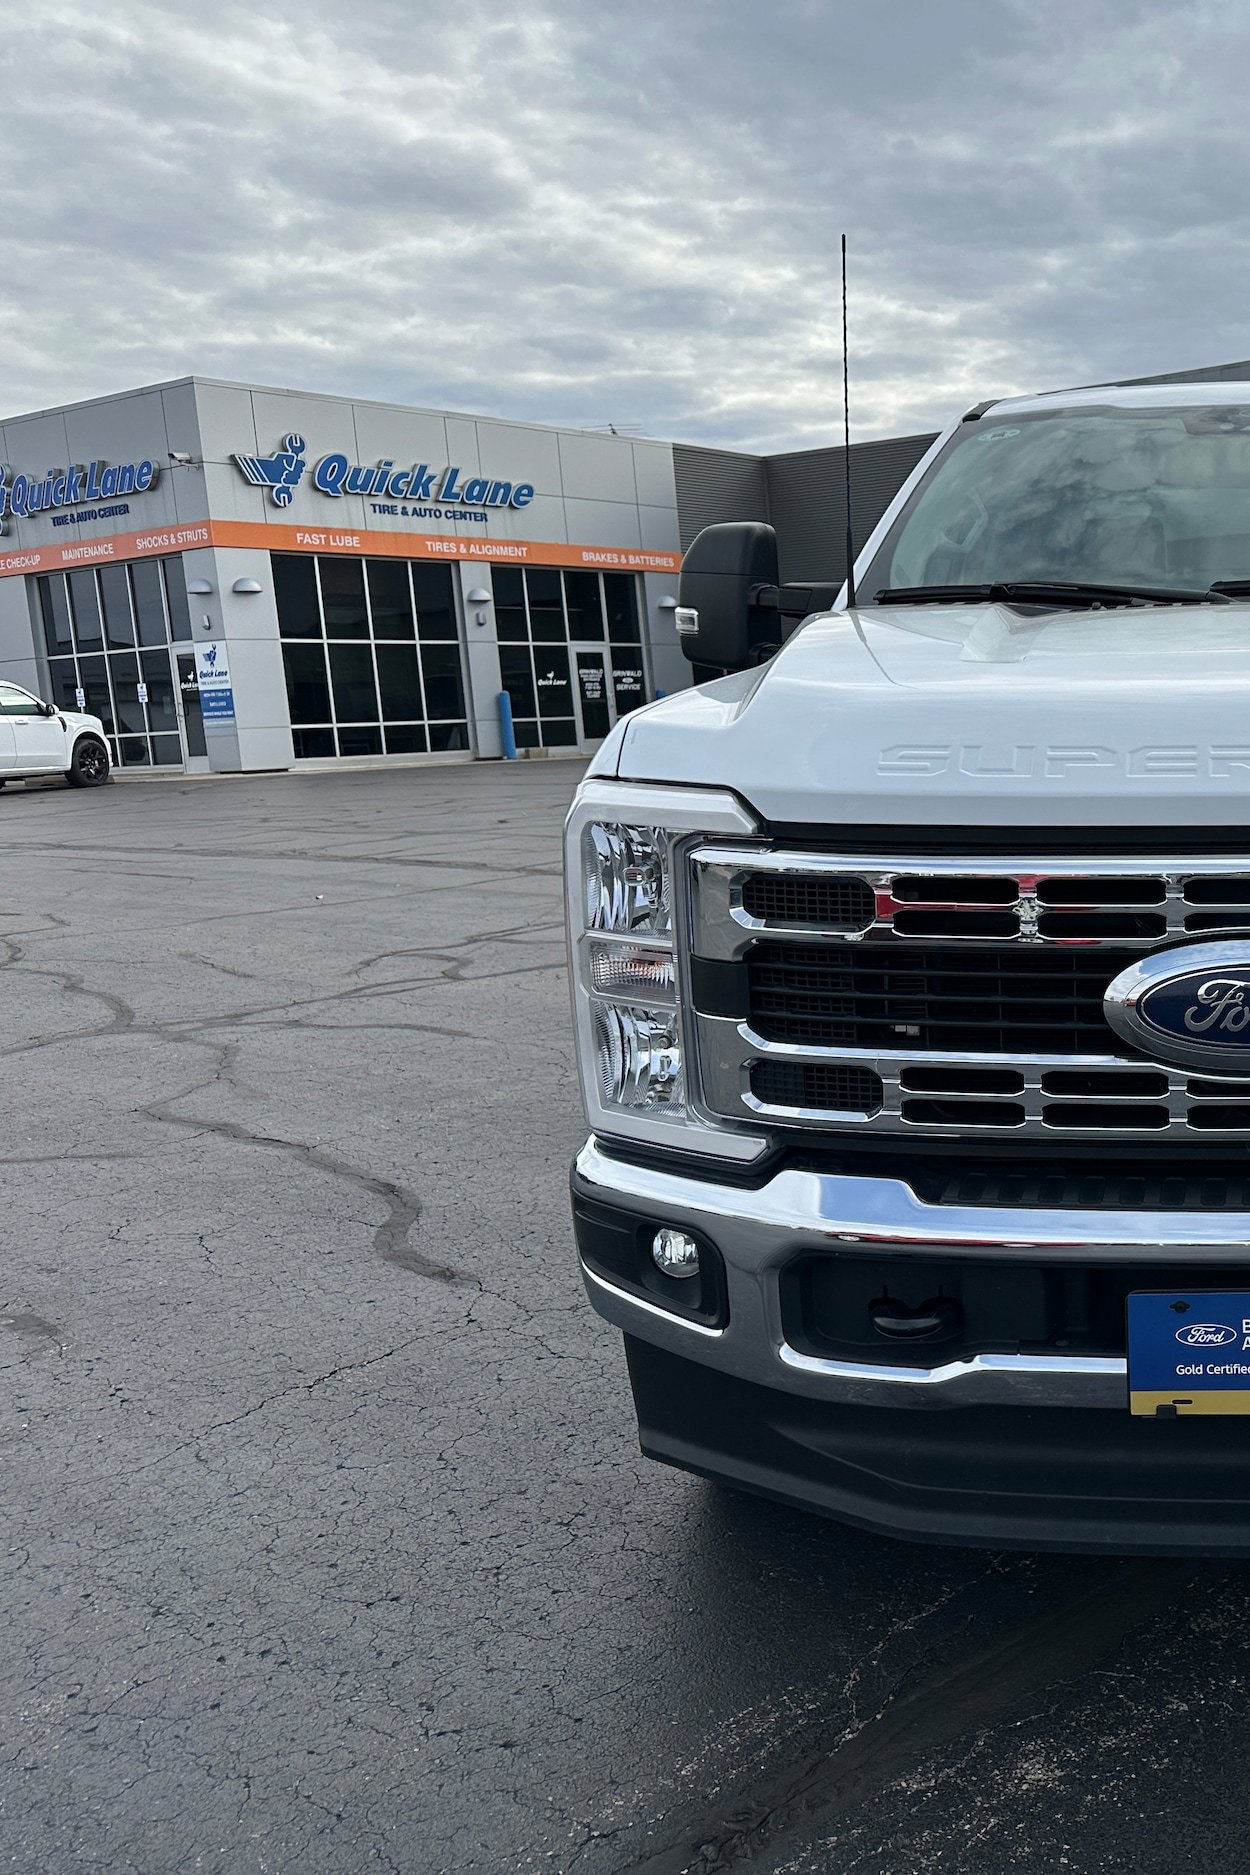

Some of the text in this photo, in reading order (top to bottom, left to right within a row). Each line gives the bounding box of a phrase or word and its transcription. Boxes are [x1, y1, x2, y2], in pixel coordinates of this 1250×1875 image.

[10, 459, 157, 519] Quick Lane
[313, 453, 536, 509] Quick Lane
[51, 503, 130, 528] TIRE & AUTO CENTER
[370, 503, 489, 523] TIRE & AUTO CENTER
[136, 527, 209, 550] SHOCKS & STRUTS
[296, 532, 361, 548] FAST LUBE
[61, 543, 114, 561] MAINTENANCE
[425, 540, 528, 558] TIRES & ALIGNMENT
[6, 554, 41, 570] CHECK-UP
[582, 551, 675, 568] BRAKES & BATTERIES
[199, 669, 228, 679] Quick Lane
[537, 678, 567, 686] Quick Lane
[1187, 1326, 1226, 1343] Ford
[1175, 1364, 1204, 1375] Gold
